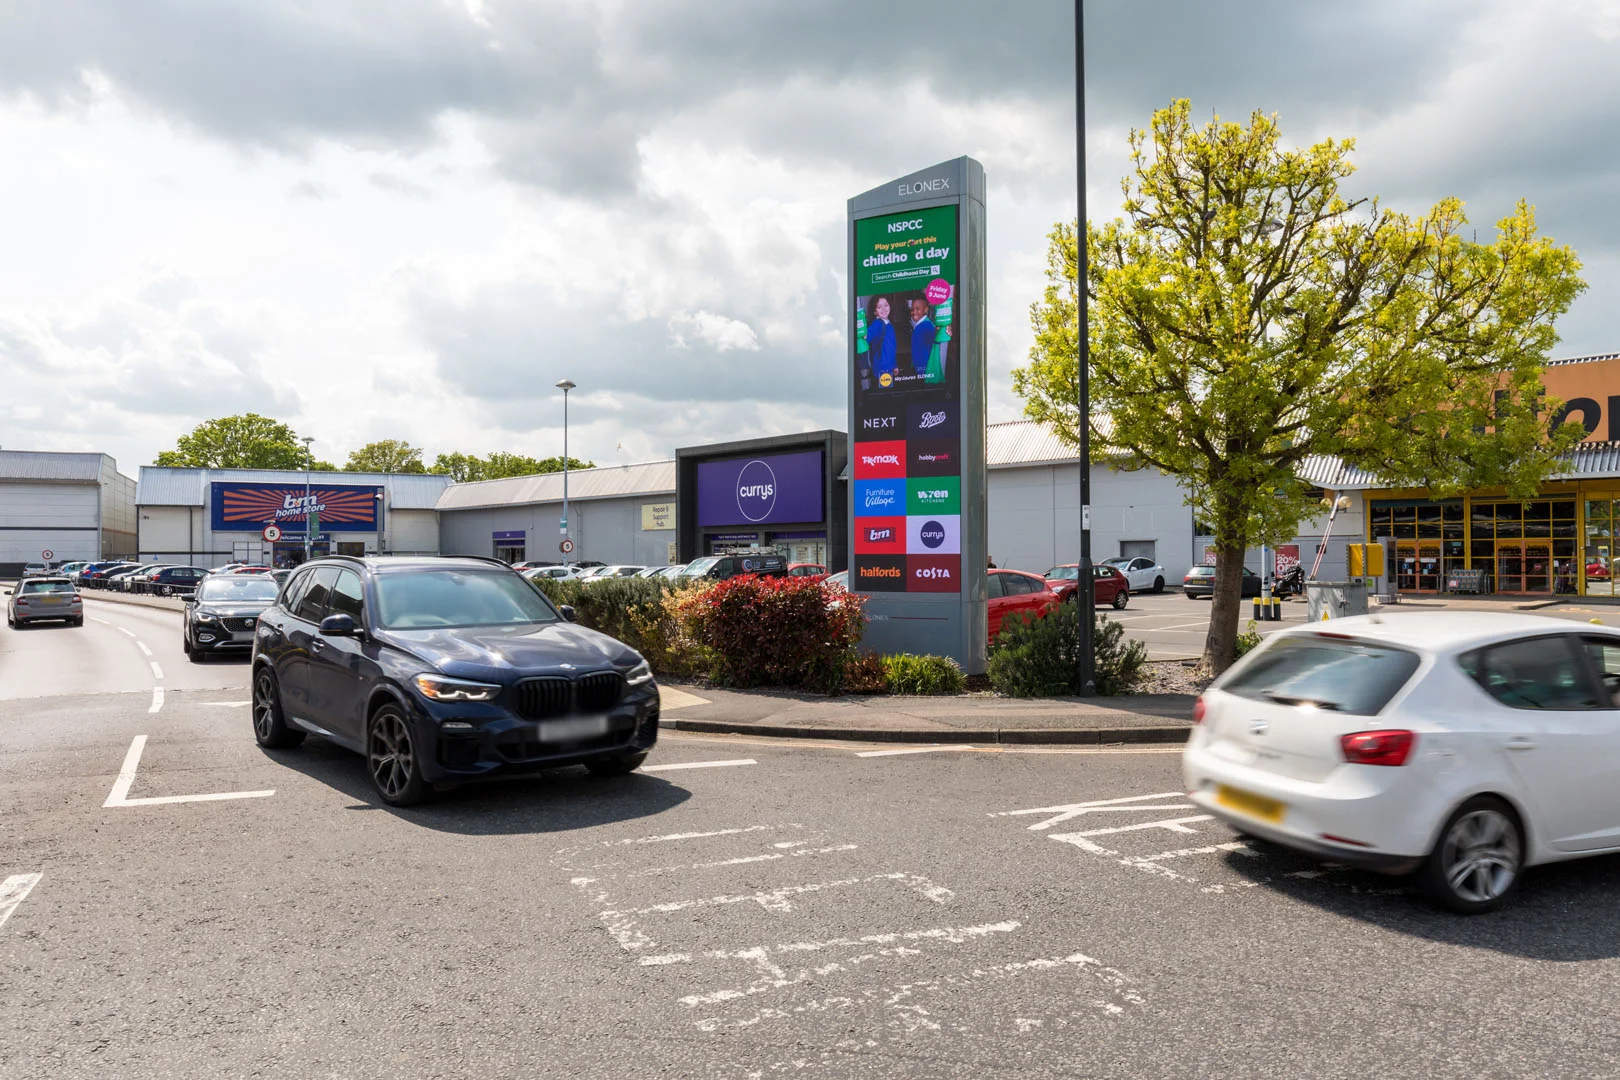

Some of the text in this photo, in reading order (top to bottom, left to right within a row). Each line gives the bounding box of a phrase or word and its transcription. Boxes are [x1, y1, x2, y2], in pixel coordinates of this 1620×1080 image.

[898, 178, 951, 196] ELONEX
[888, 219, 923, 233] NSPCC
[874, 243, 889, 251] Play
[891, 241, 907, 249] your
[926, 247, 950, 259] day
[892, 270, 918, 278] Childhood
[930, 285, 948, 294] Friday
[863, 417, 897, 429] NEXT
[919, 411, 947, 429] Boots
[918, 453, 949, 462] hobbycraft
[740, 484, 773, 500] currys
[865, 488, 894, 496] Furniture
[865, 496, 896, 508] Village
[275, 507, 302, 517] home
[269, 529, 275, 537] 5
[922, 531, 944, 540] currys
[1277, 556, 1298, 564] 20%
[860, 566, 901, 578] halfords
[916, 567, 950, 579] COSTA
